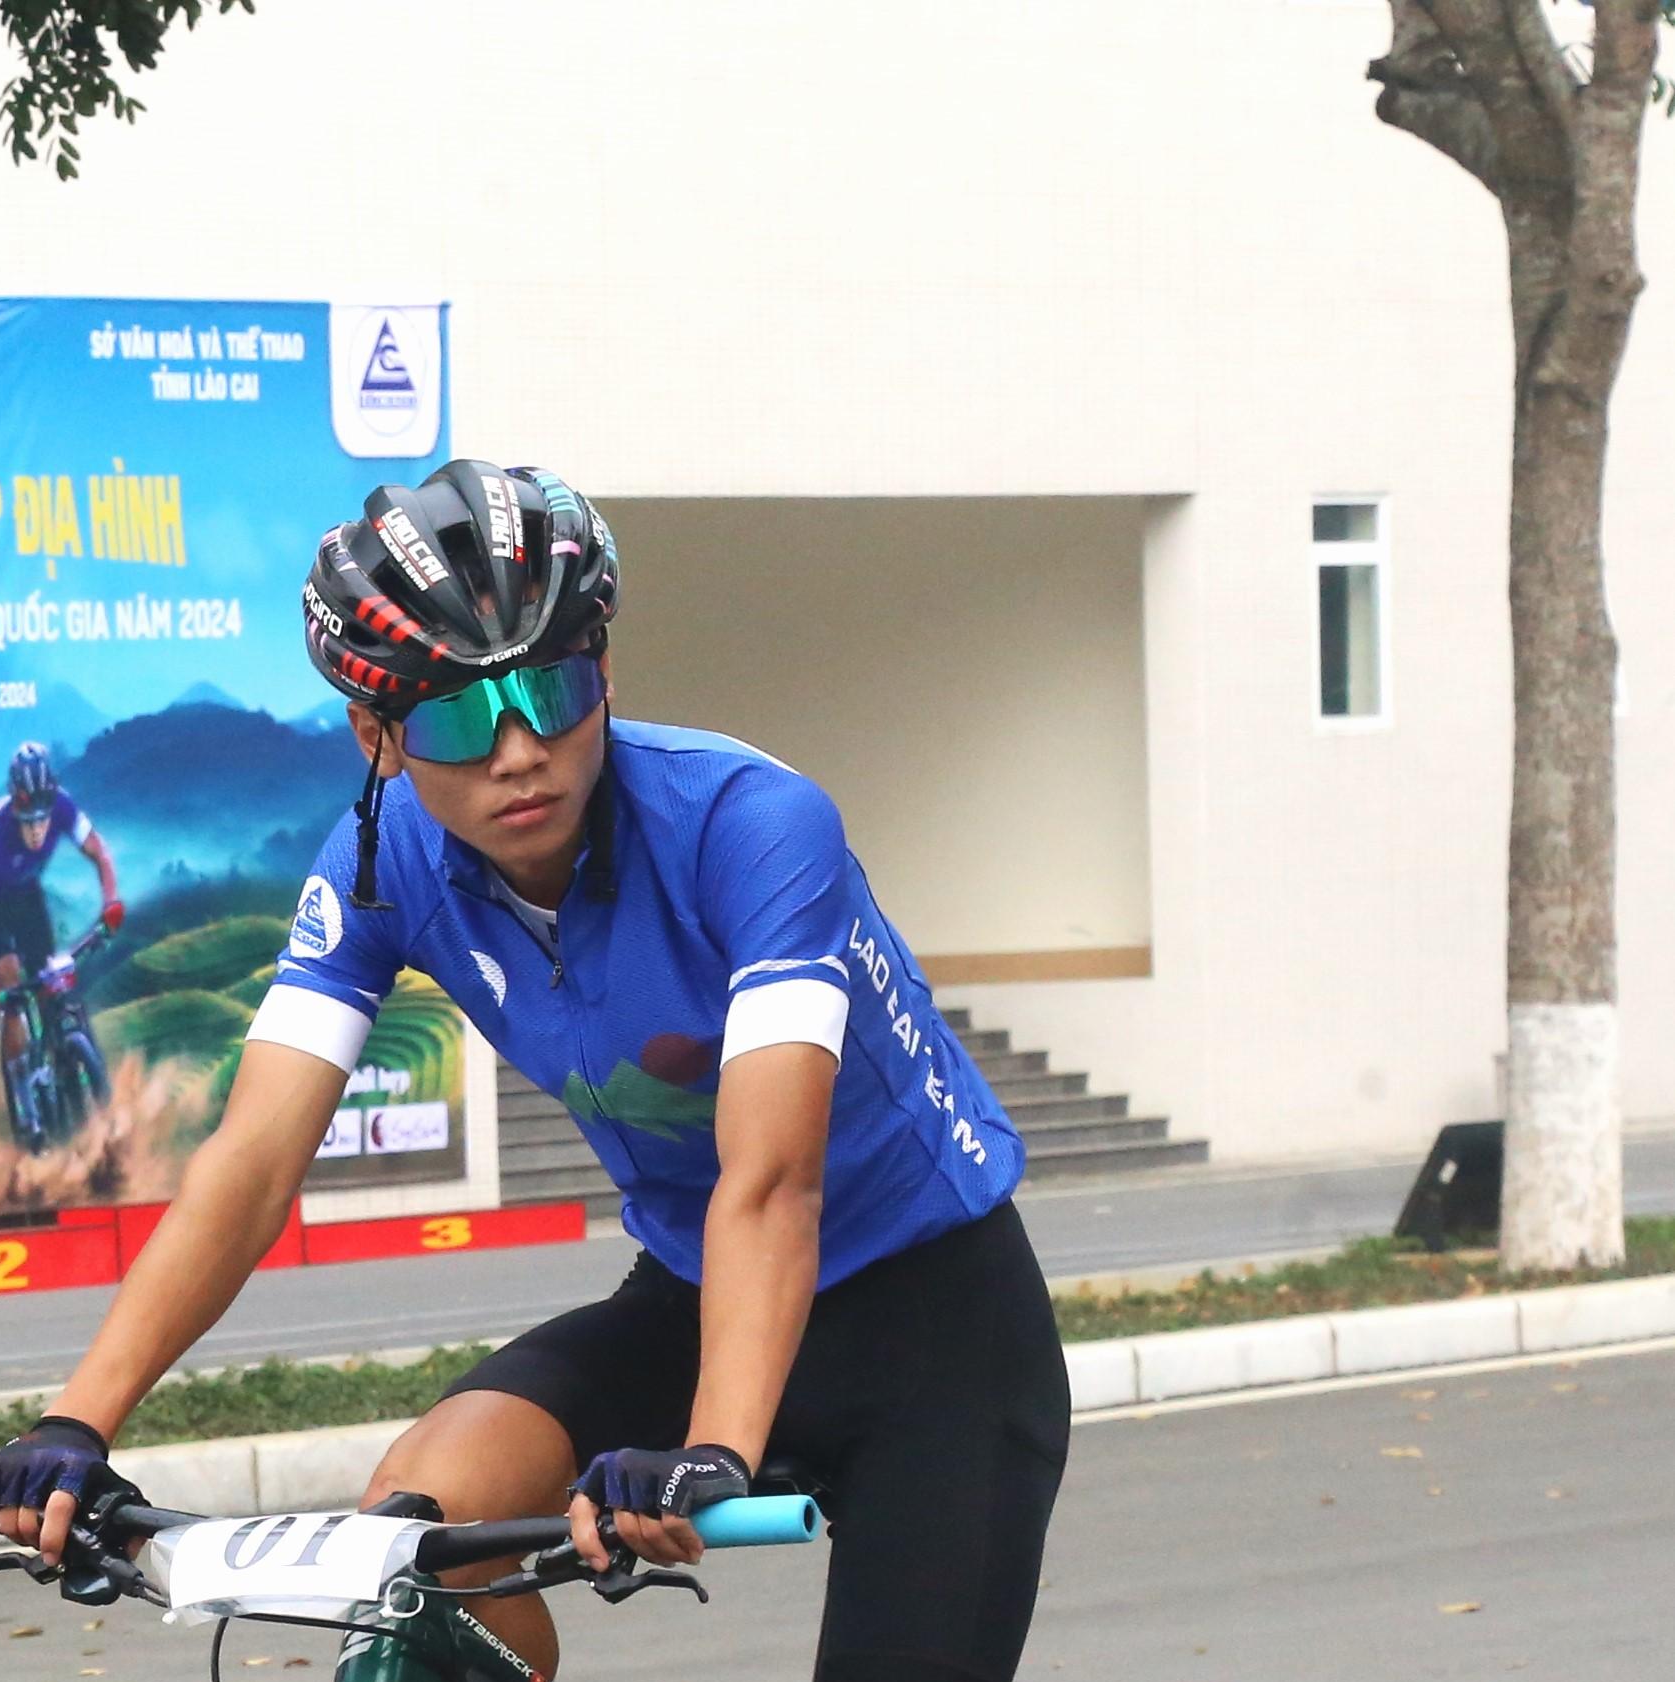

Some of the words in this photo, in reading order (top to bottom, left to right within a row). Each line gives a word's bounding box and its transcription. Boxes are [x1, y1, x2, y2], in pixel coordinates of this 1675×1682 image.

[119, 324, 156, 359] VĂN
[198, 325, 222, 359] VÀ
[260, 331, 306, 360] THAO
[151, 363, 191, 400] TỈNH
[194, 366, 228, 400] LÀO
[230, 372, 261, 400] CAI
[13, 474, 84, 581] ĐỊA
[87, 456, 188, 568] HÌNH
[385, 506, 420, 546] LAO
[407, 540, 450, 584] CAI
[66, 600, 110, 641] GIA
[115, 592, 173, 640] NĂM
[178, 598, 243, 639] 2024
[309, 594, 344, 638] GIRO
[493, 643, 530, 662] GIRO
[420, 1217, 474, 1250] 3
